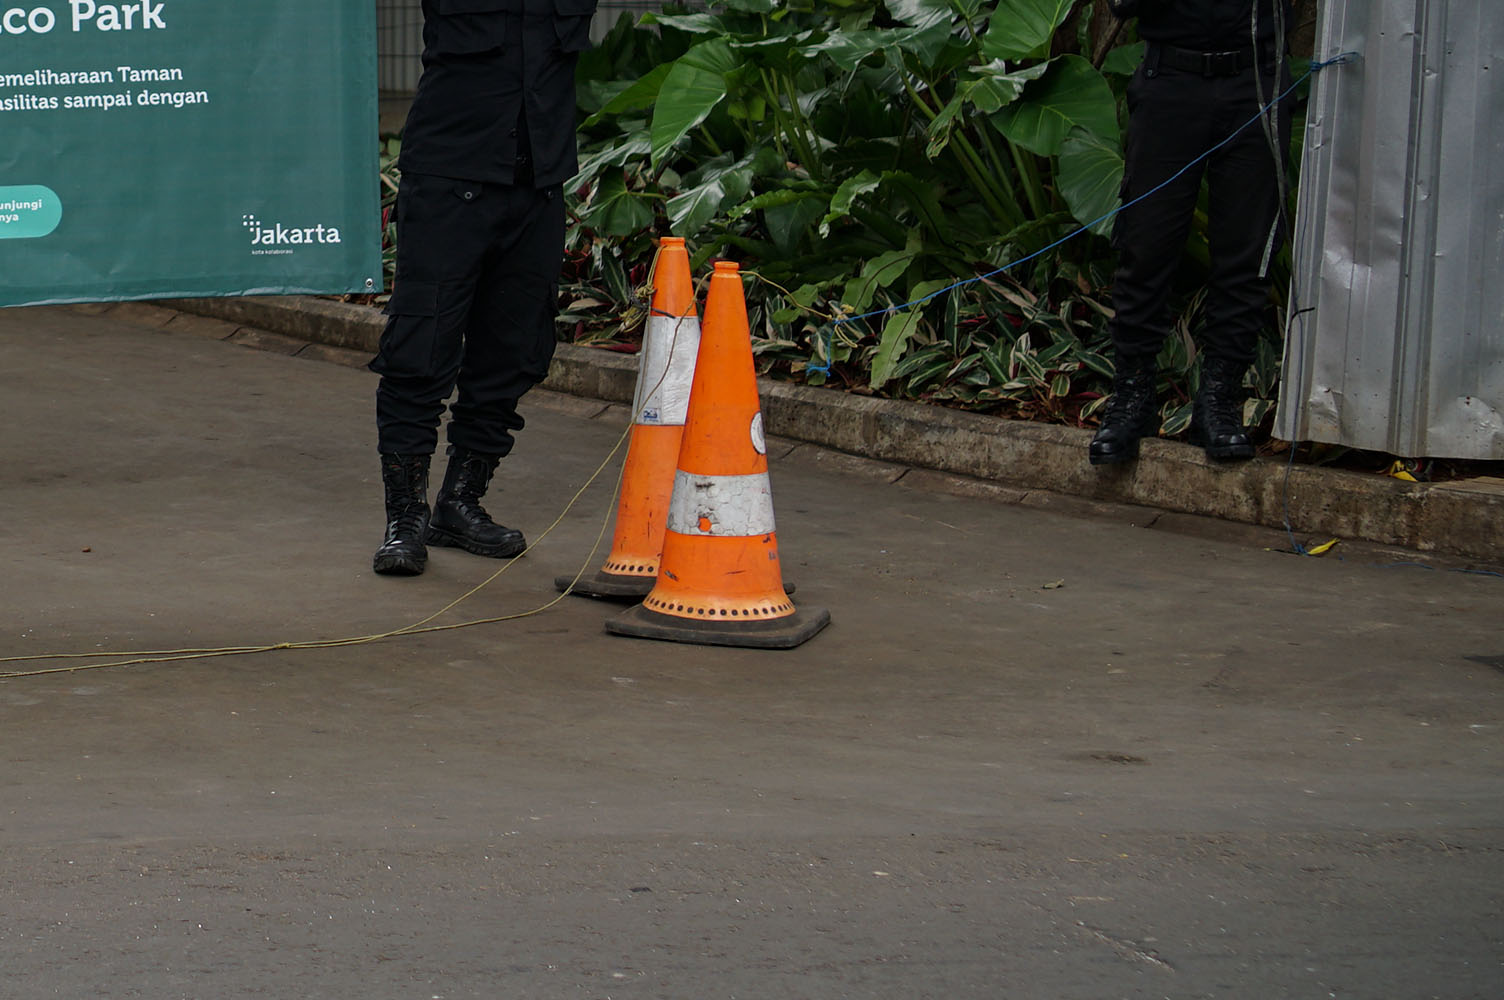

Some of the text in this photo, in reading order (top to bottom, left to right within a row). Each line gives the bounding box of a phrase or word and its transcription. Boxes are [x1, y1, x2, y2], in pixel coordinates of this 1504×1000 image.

[117, 65, 184, 83] Taman
[63, 90, 133, 112] sampai
[136, 88, 209, 110] dengan
